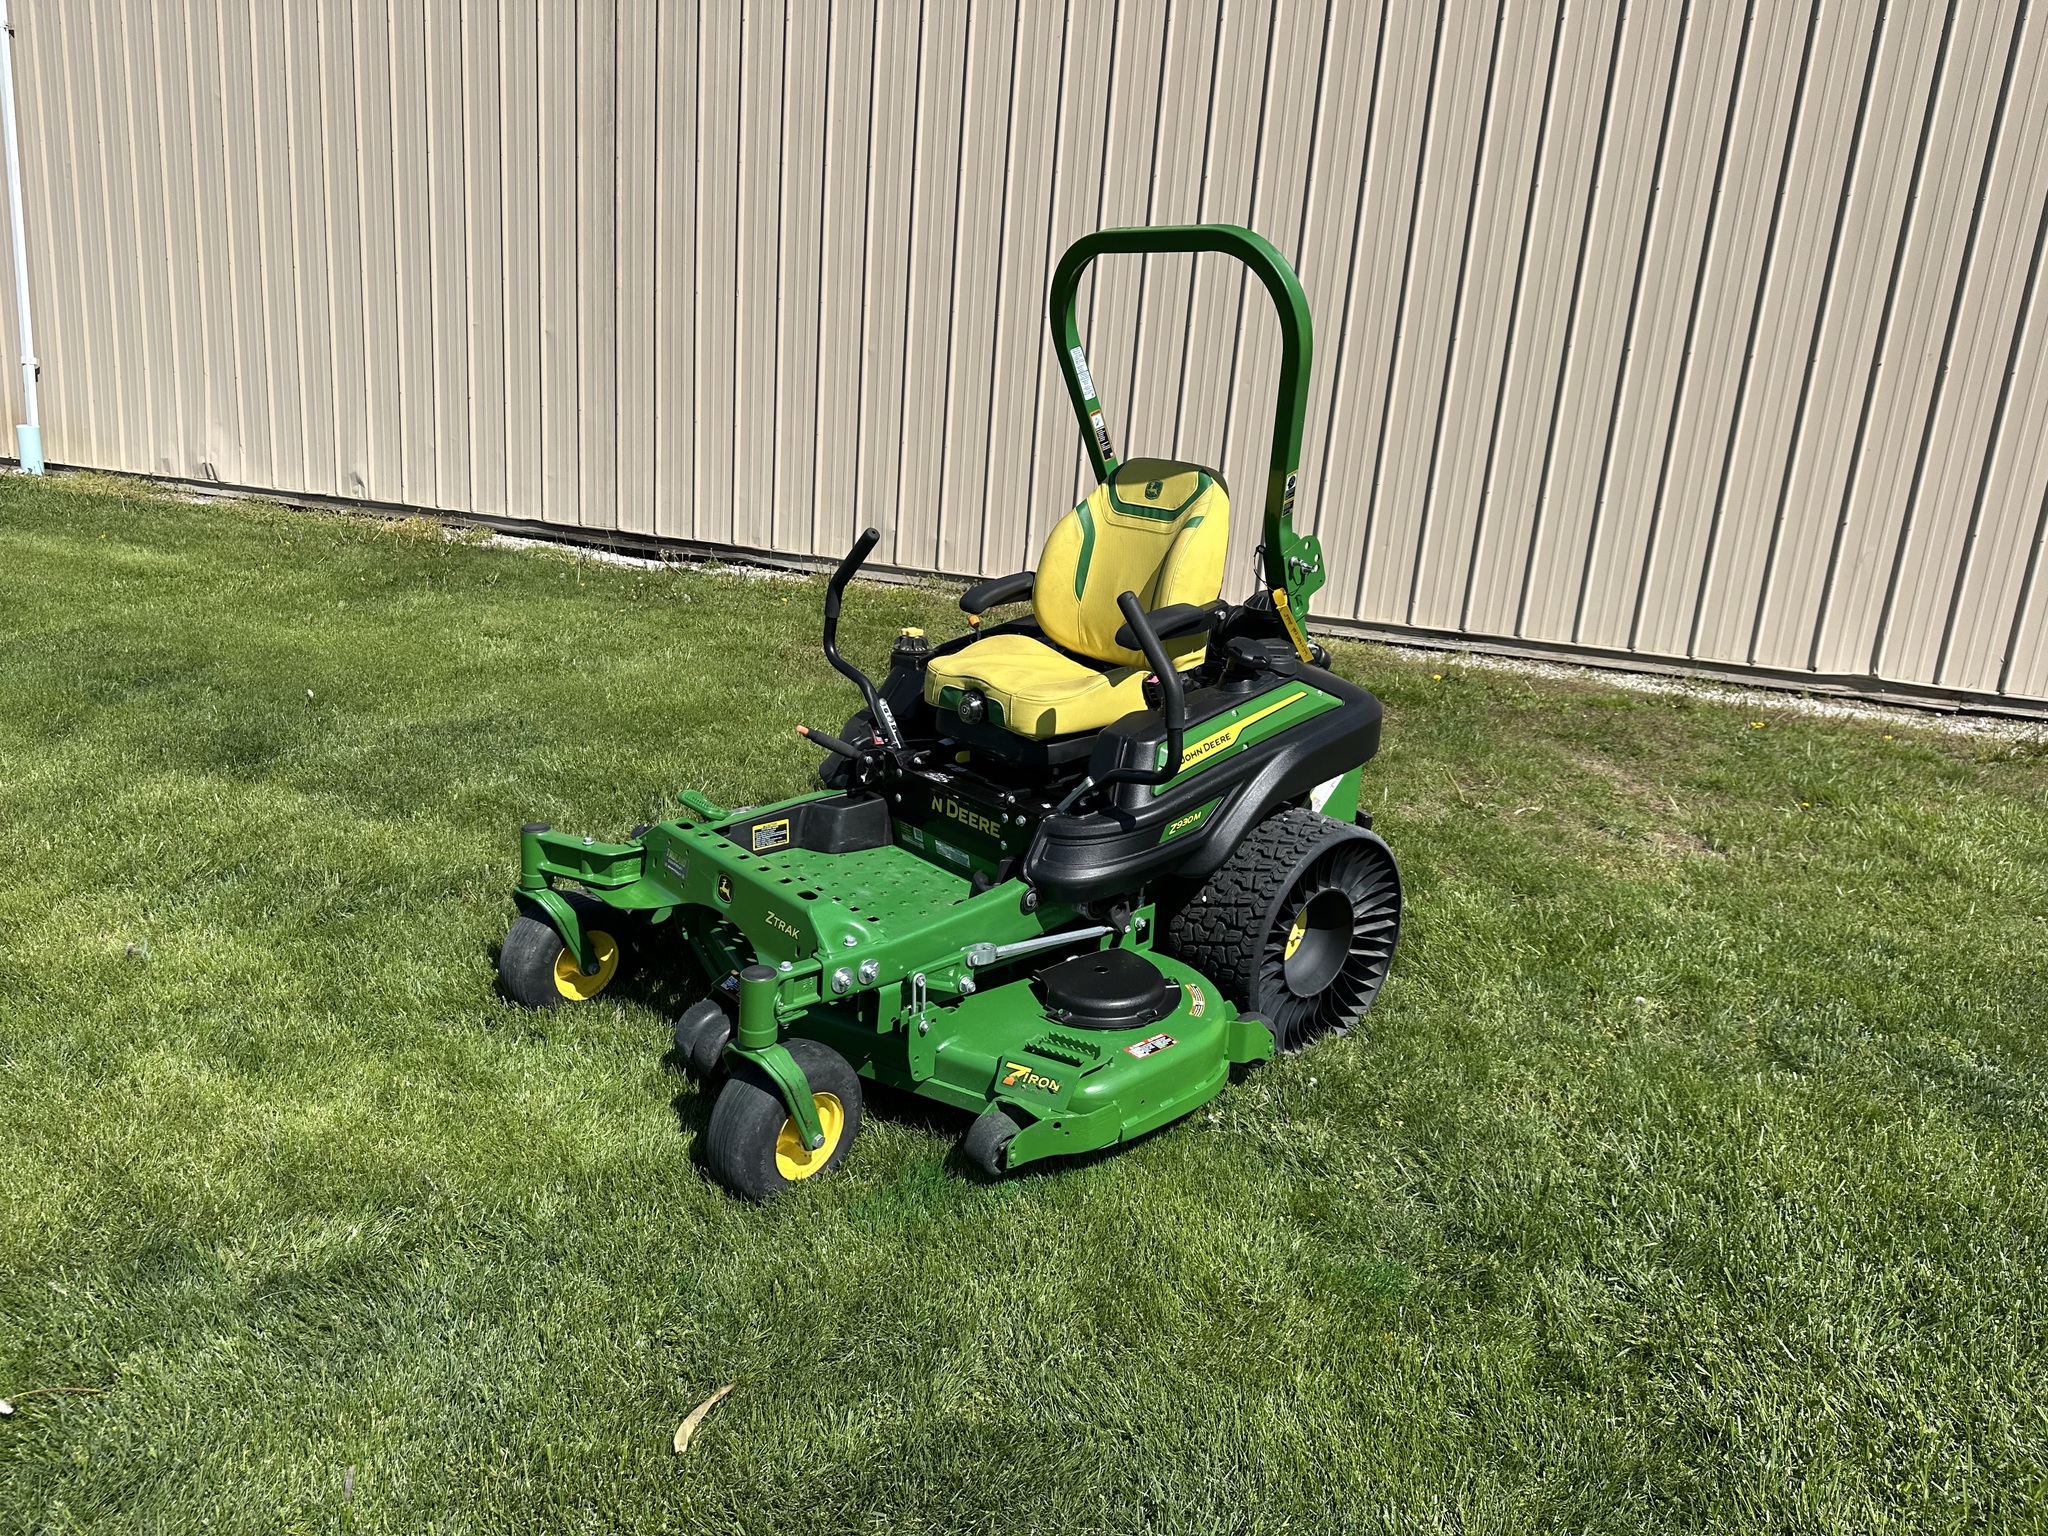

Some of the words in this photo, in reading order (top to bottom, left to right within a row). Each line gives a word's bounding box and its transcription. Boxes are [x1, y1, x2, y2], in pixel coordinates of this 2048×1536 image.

[1203, 733, 1231, 752] DEERE
[946, 799, 1001, 839] DEERE
[1168, 811, 1202, 835] Z930M
[765, 910, 800, 940] ZTRAK
